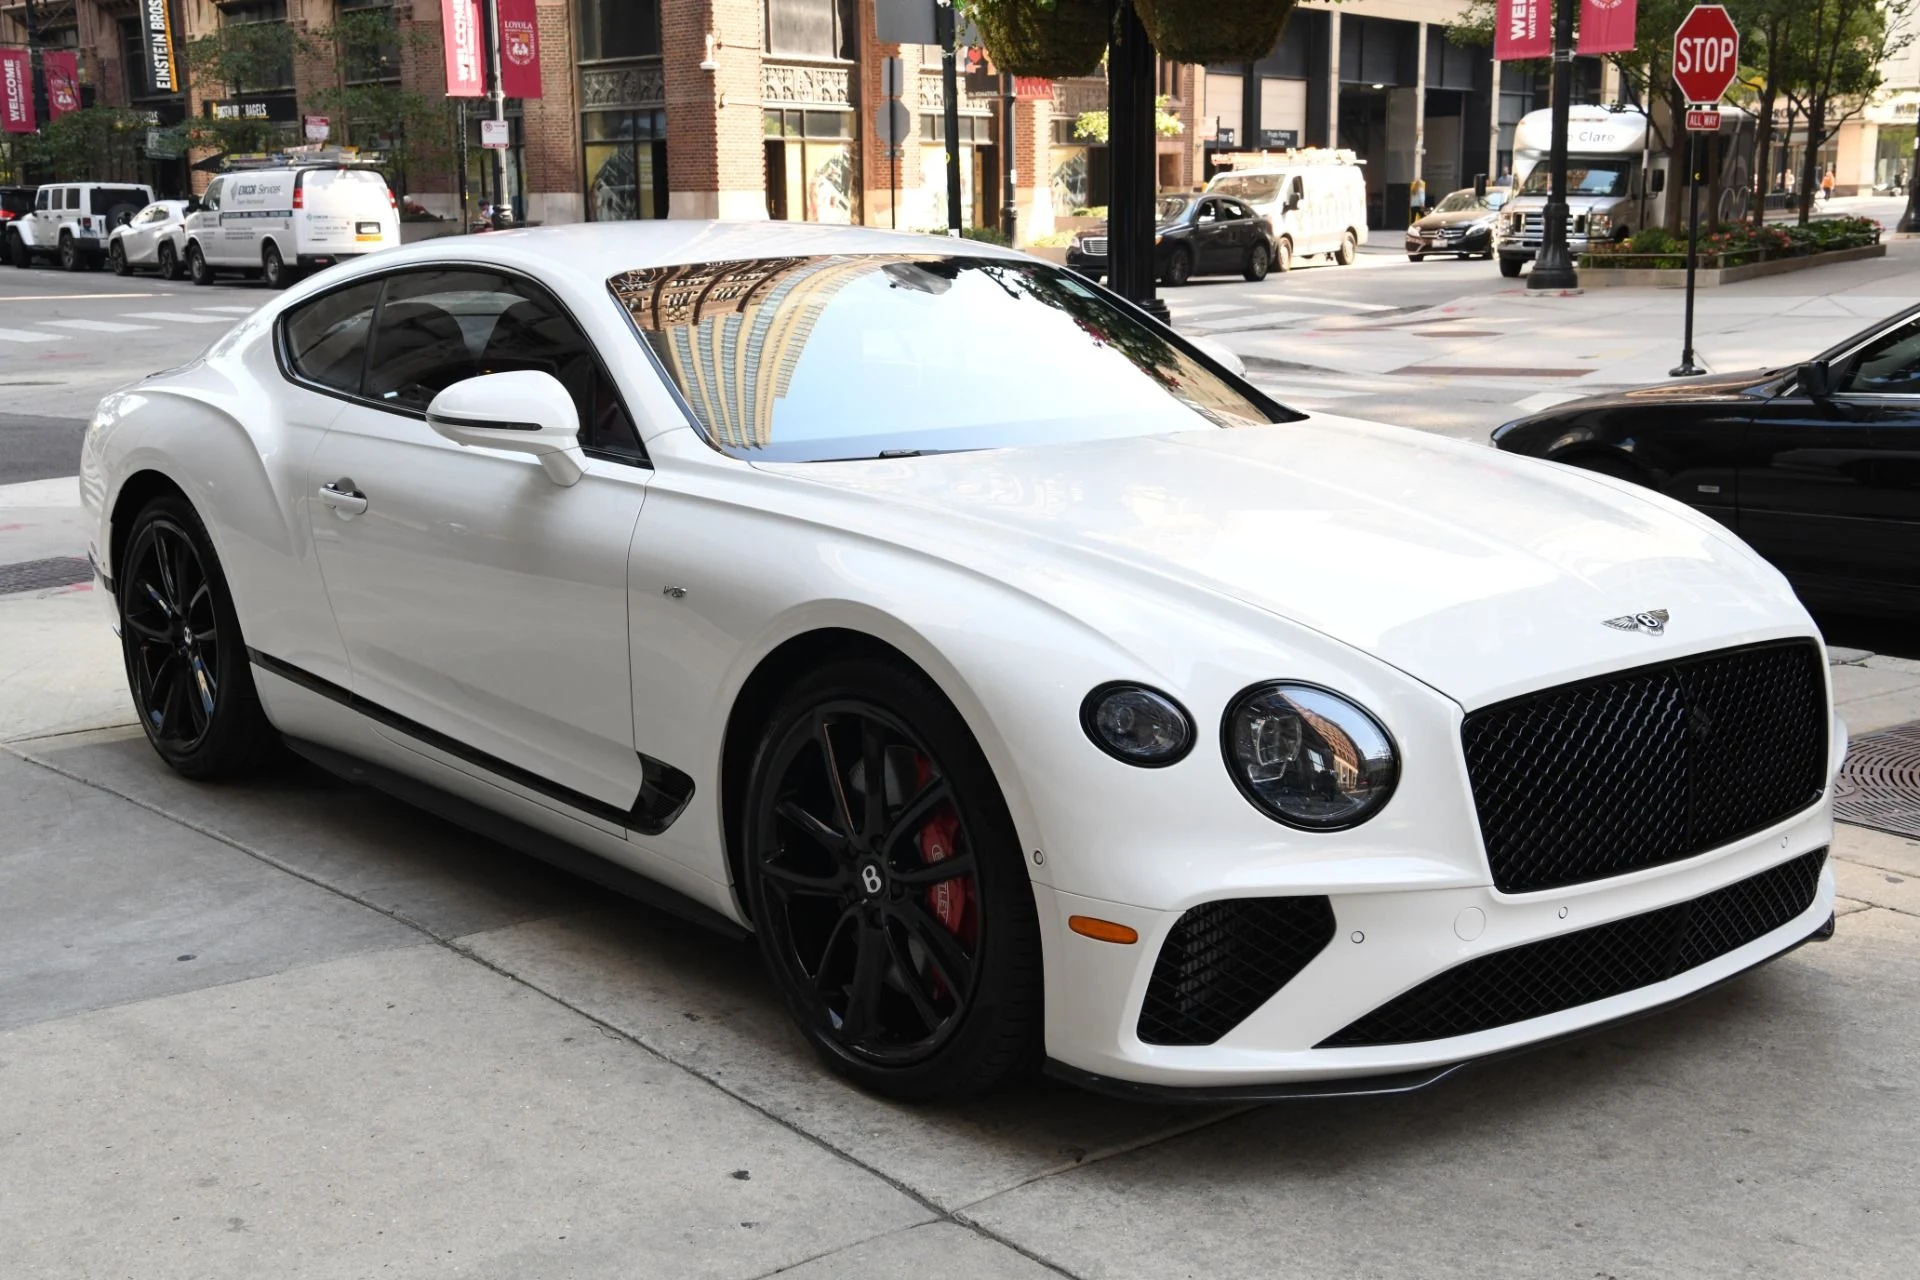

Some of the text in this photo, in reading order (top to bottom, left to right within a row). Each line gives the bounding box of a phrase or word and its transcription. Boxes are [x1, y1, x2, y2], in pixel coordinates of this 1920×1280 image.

[504, 21, 533, 29] LOYOLA
[1528, 6, 1536, 40] WATER
[151, 34, 171, 88] EINSTEIN
[1678, 37, 1734, 73] STOP
[4, 59, 20, 121] WELCOME
[245, 103, 267, 117] BAGELS
[1689, 115, 1718, 126] ALL WAY
[1579, 131, 1615, 142] Clare
[258, 184, 281, 194] Services
